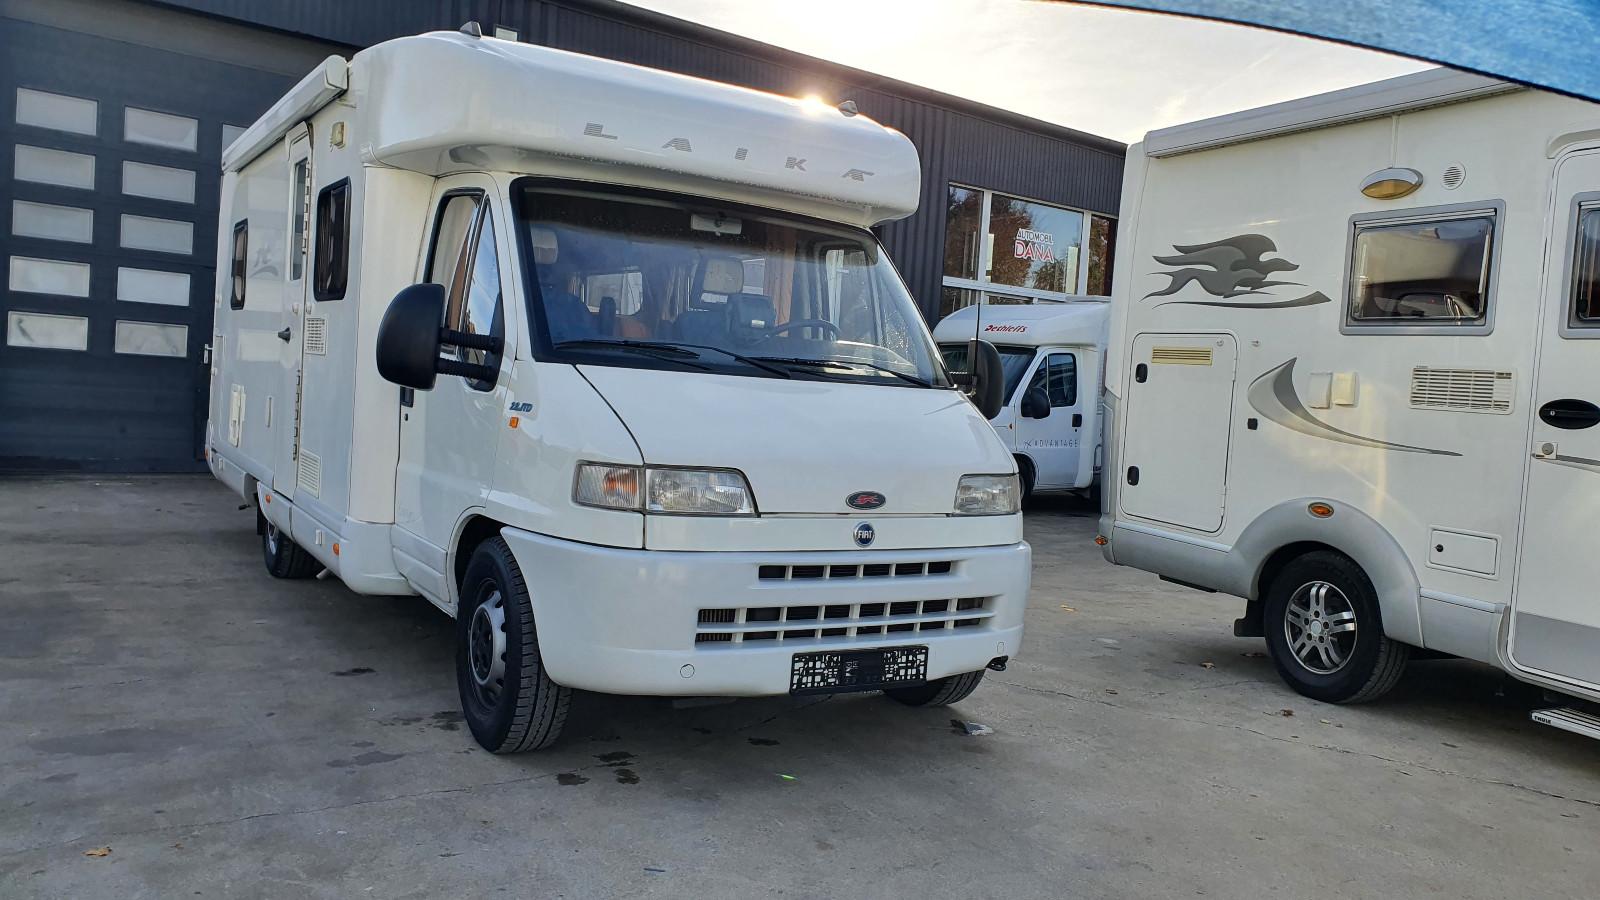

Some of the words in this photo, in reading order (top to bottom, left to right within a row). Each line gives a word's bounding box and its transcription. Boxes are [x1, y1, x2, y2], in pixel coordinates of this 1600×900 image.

[584, 122, 875, 182] LAIKA
[1014, 240, 1055, 264] DANA
[858, 530, 873, 539] FIAT
[1534, 715, 1552, 725] THULE
